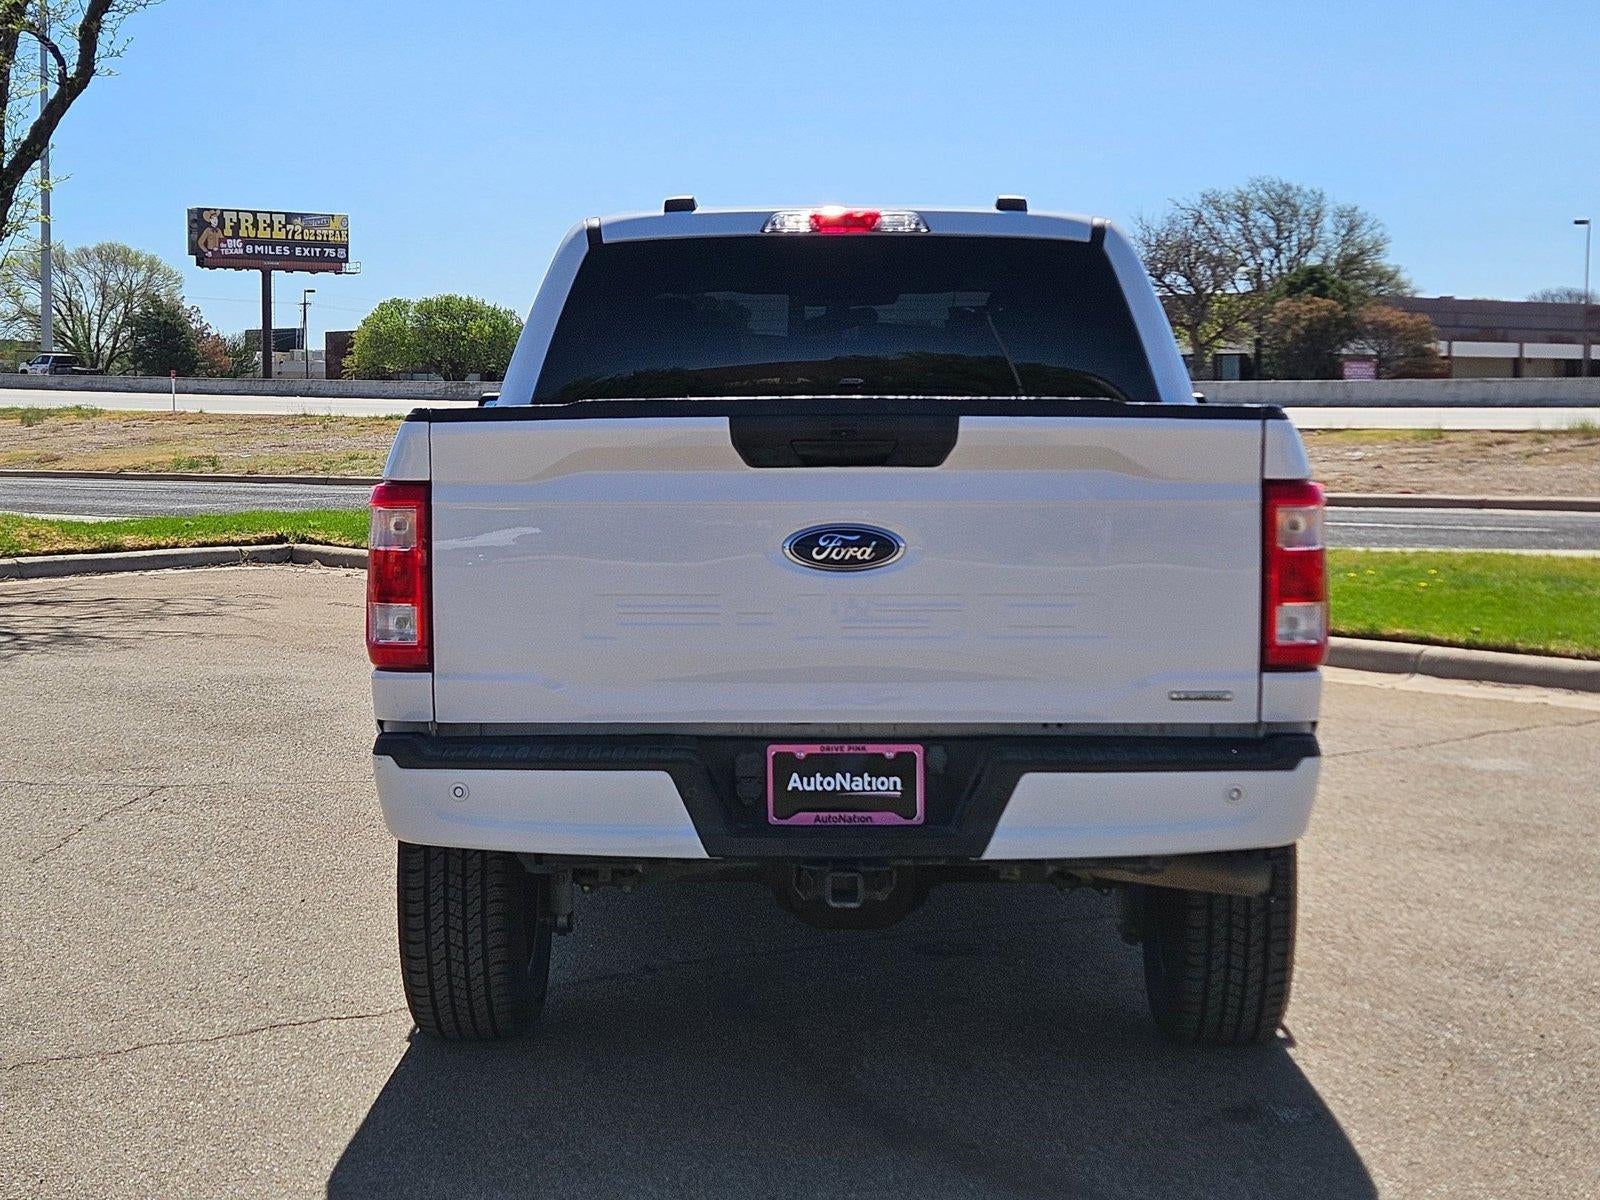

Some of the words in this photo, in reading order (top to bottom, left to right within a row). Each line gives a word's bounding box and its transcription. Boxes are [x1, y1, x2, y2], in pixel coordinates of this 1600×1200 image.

[222, 211, 286, 239] FREE
[286, 224, 302, 240] 72
[303, 228, 315, 240] OZ
[316, 229, 348, 242] STEAK
[226, 239, 243, 248] BIG
[245, 244, 253, 254] 8
[254, 244, 290, 255] MILES
[295, 246, 321, 257] EXIT
[323, 248, 336, 257] 75
[811, 533, 877, 560] Ford
[786, 772, 902, 792] AutoNation
[813, 814, 873, 824] AutoNation
